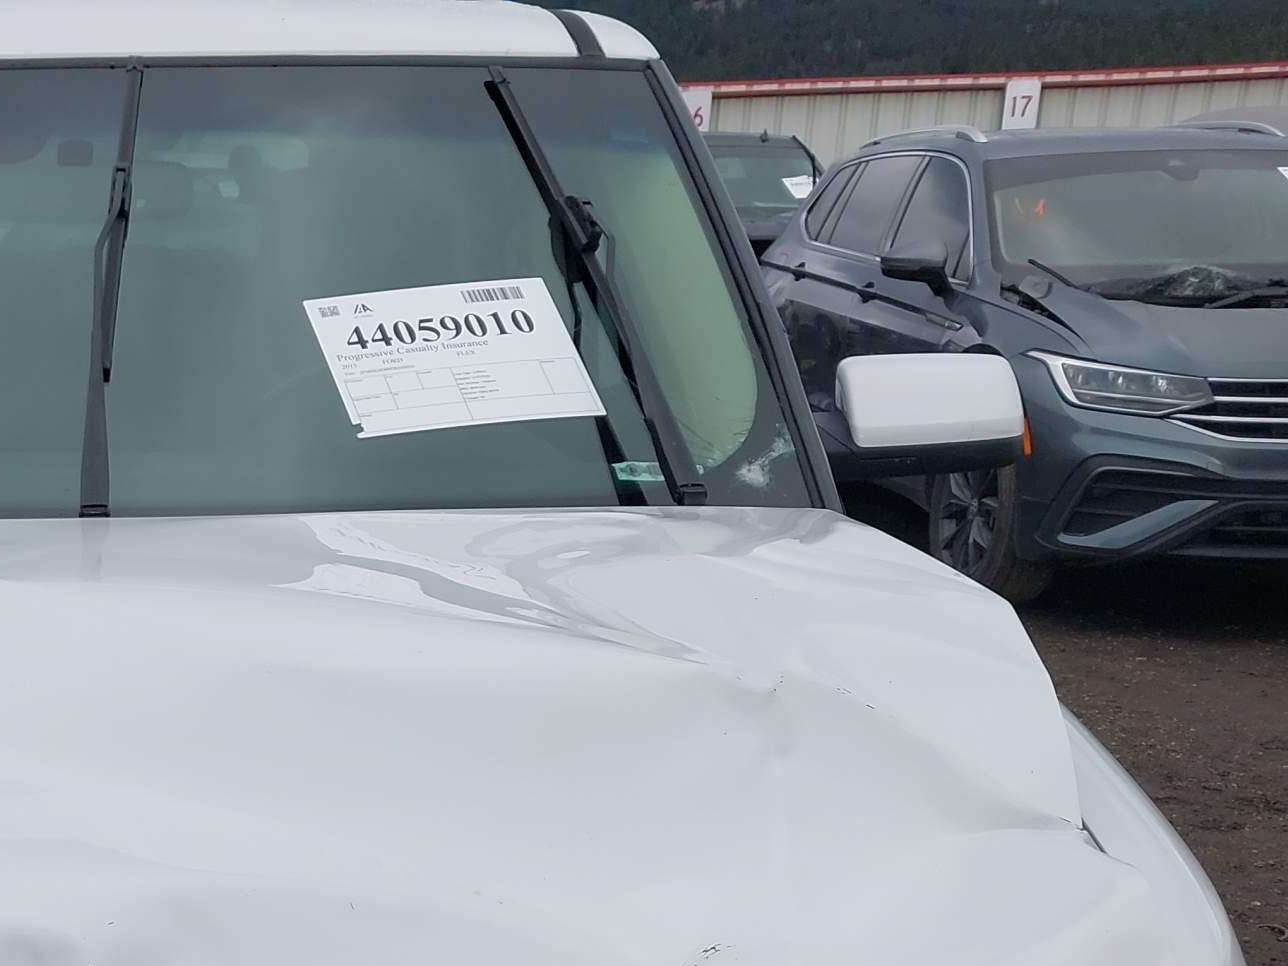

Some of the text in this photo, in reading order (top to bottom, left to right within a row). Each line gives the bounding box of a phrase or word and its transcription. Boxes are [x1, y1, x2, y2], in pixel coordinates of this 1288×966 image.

[1011, 95, 1033, 118] 17
[347, 309, 535, 349] 44059010
[336, 338, 489, 363] Progressive Casualty Insurance
